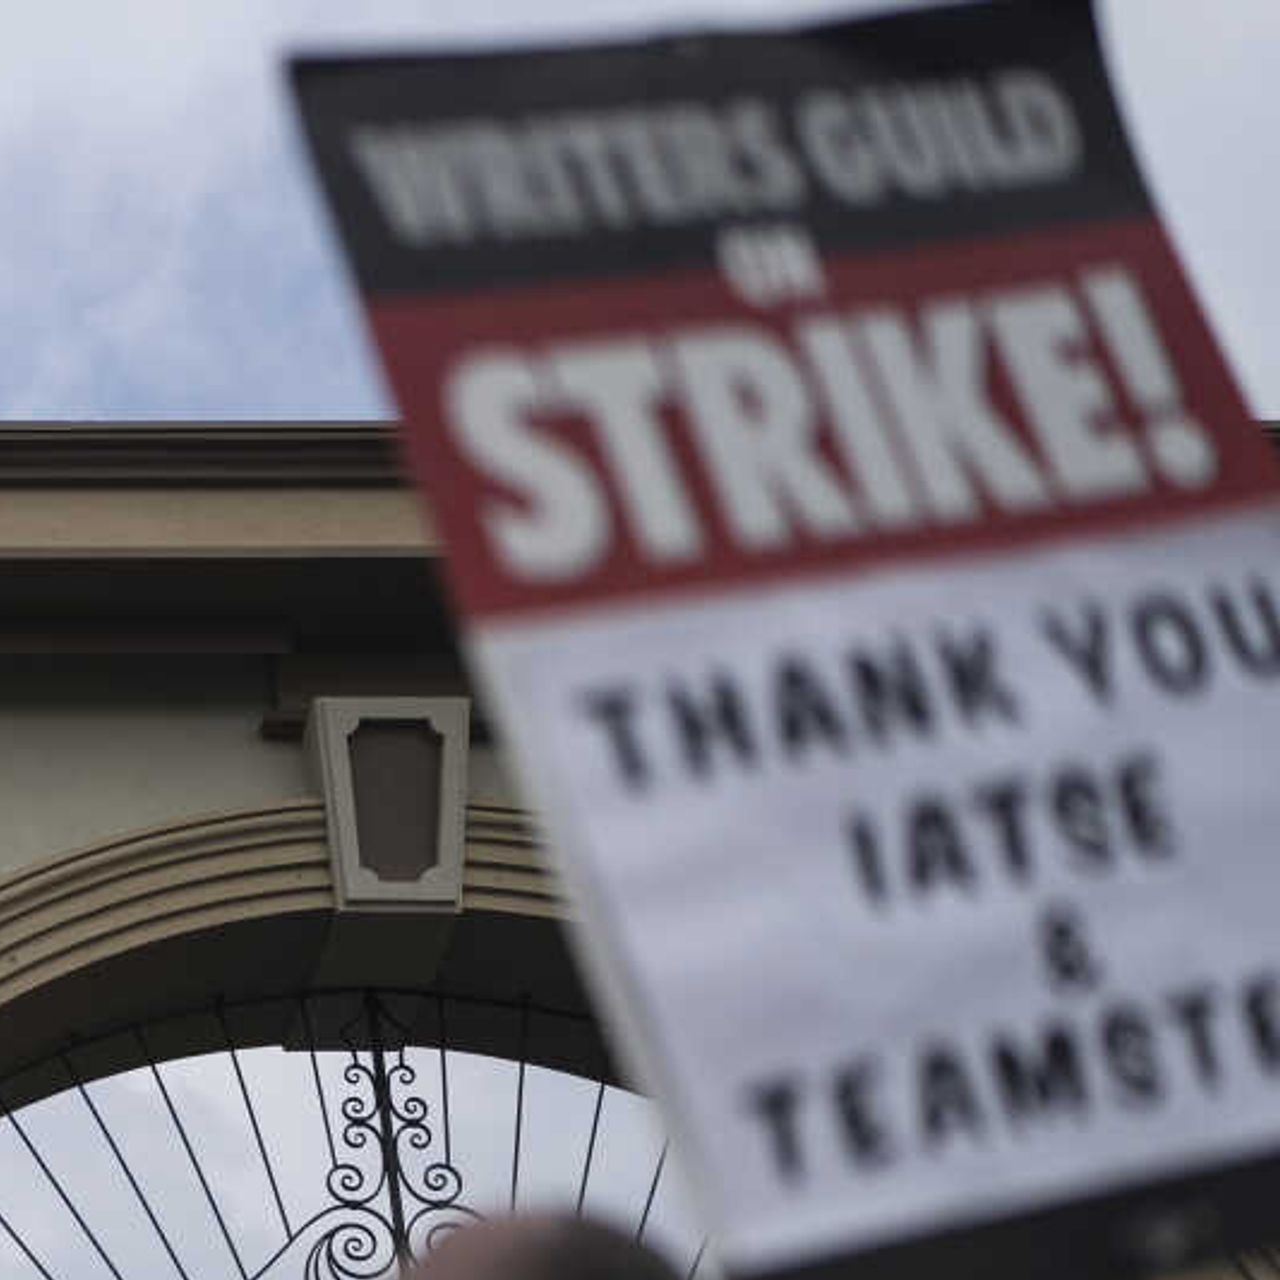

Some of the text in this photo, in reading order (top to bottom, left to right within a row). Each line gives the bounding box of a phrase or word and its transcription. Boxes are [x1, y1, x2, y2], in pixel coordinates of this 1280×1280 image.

[349, 70, 1086, 243] WRITERS GUILD
[716, 222, 827, 306] ON
[444, 264, 1221, 586] STRIKE!
[572, 575, 1280, 800] THANK YOU
[846, 750, 1180, 909] IATSE
